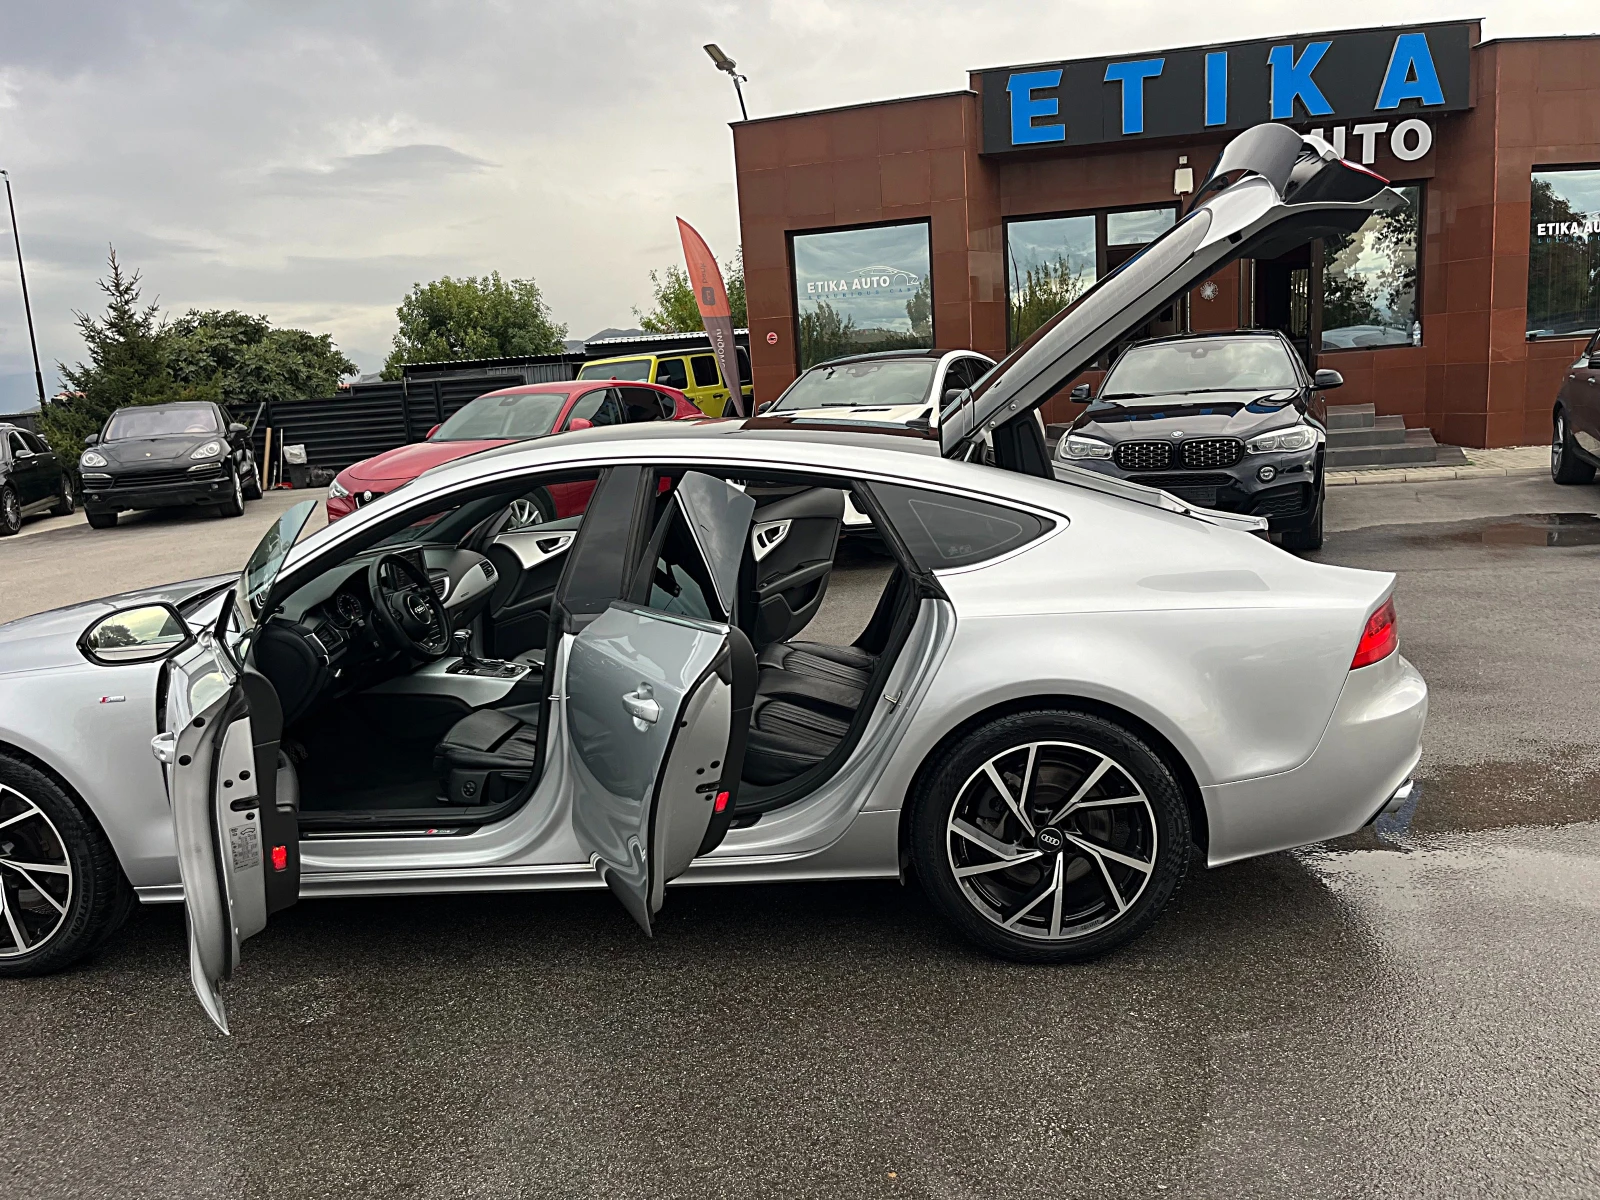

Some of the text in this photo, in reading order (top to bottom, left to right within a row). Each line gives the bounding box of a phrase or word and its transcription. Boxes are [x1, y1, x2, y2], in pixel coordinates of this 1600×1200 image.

[1310, 118, 1432, 165] UTO
[1536, 220, 1600, 236] ETIKA AU
[807, 275, 890, 294] ETIKA AUTO
